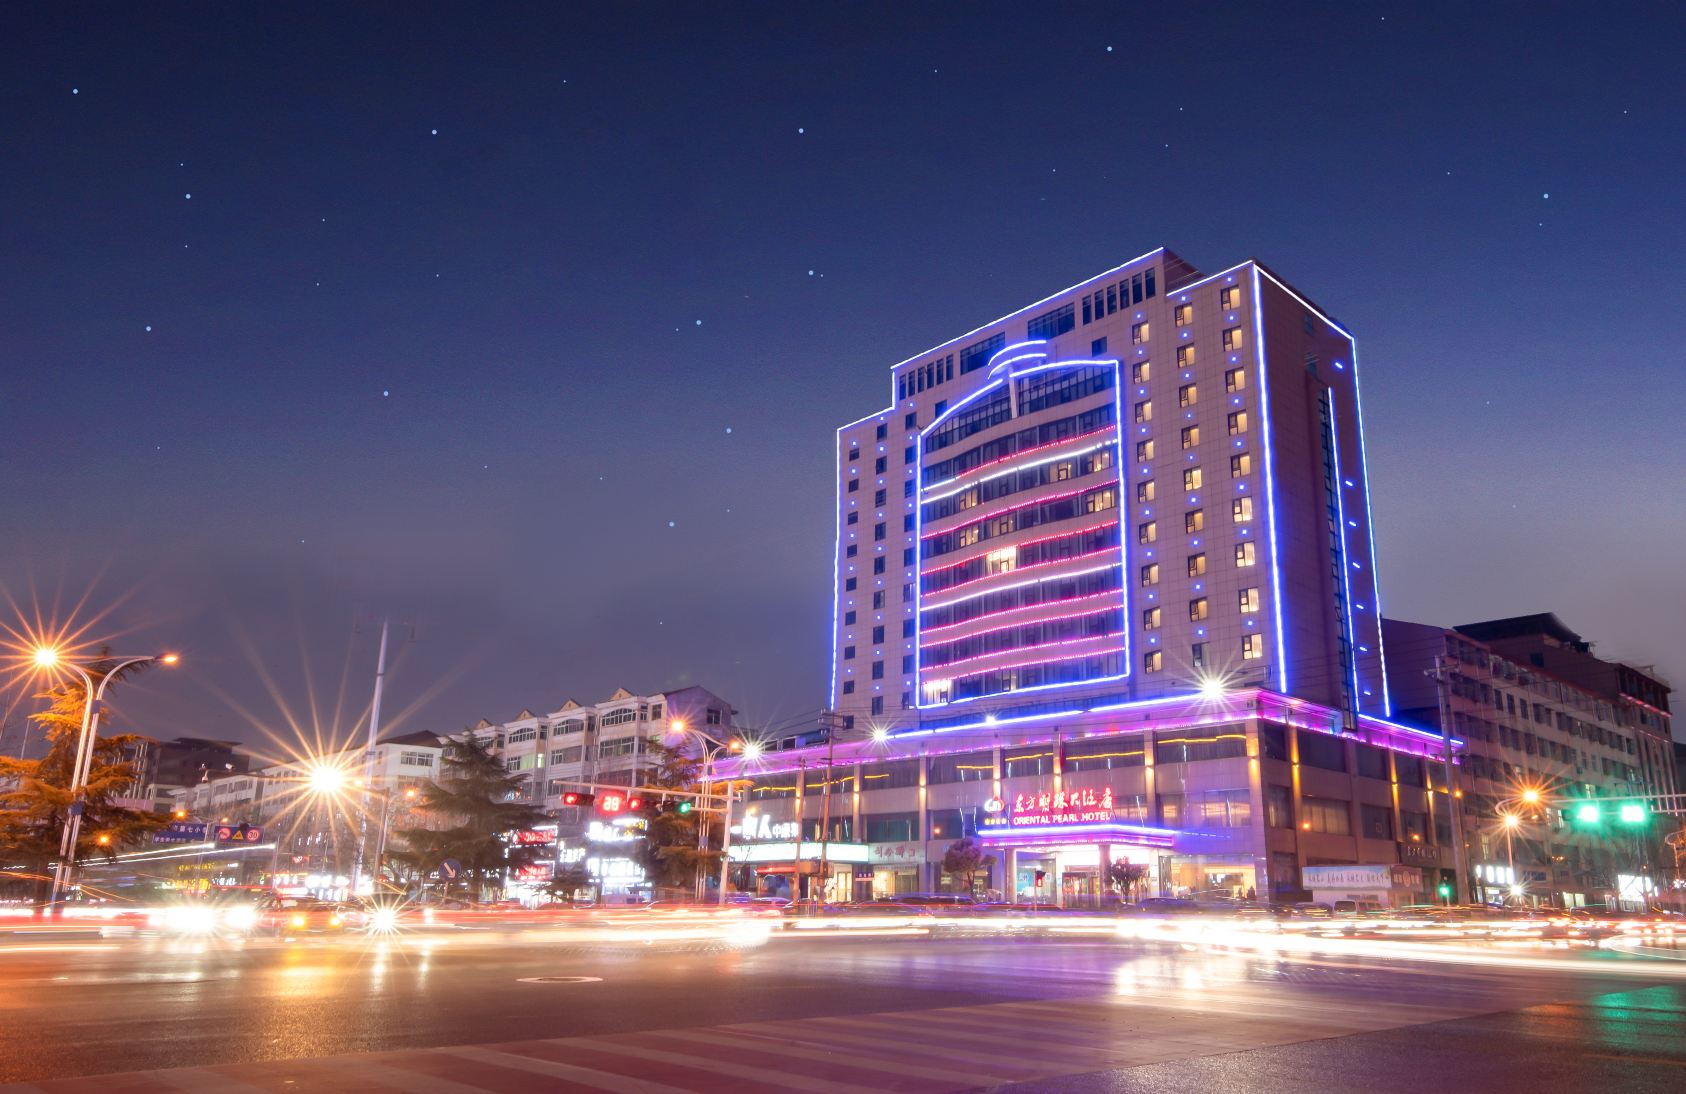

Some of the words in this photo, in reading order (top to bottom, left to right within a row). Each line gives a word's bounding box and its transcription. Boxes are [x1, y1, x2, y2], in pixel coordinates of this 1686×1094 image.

[1013, 815, 1051, 825] ORIENTAL
[1052, 813, 1079, 823] PEARL
[1082, 811, 1111, 821] HOTEL
